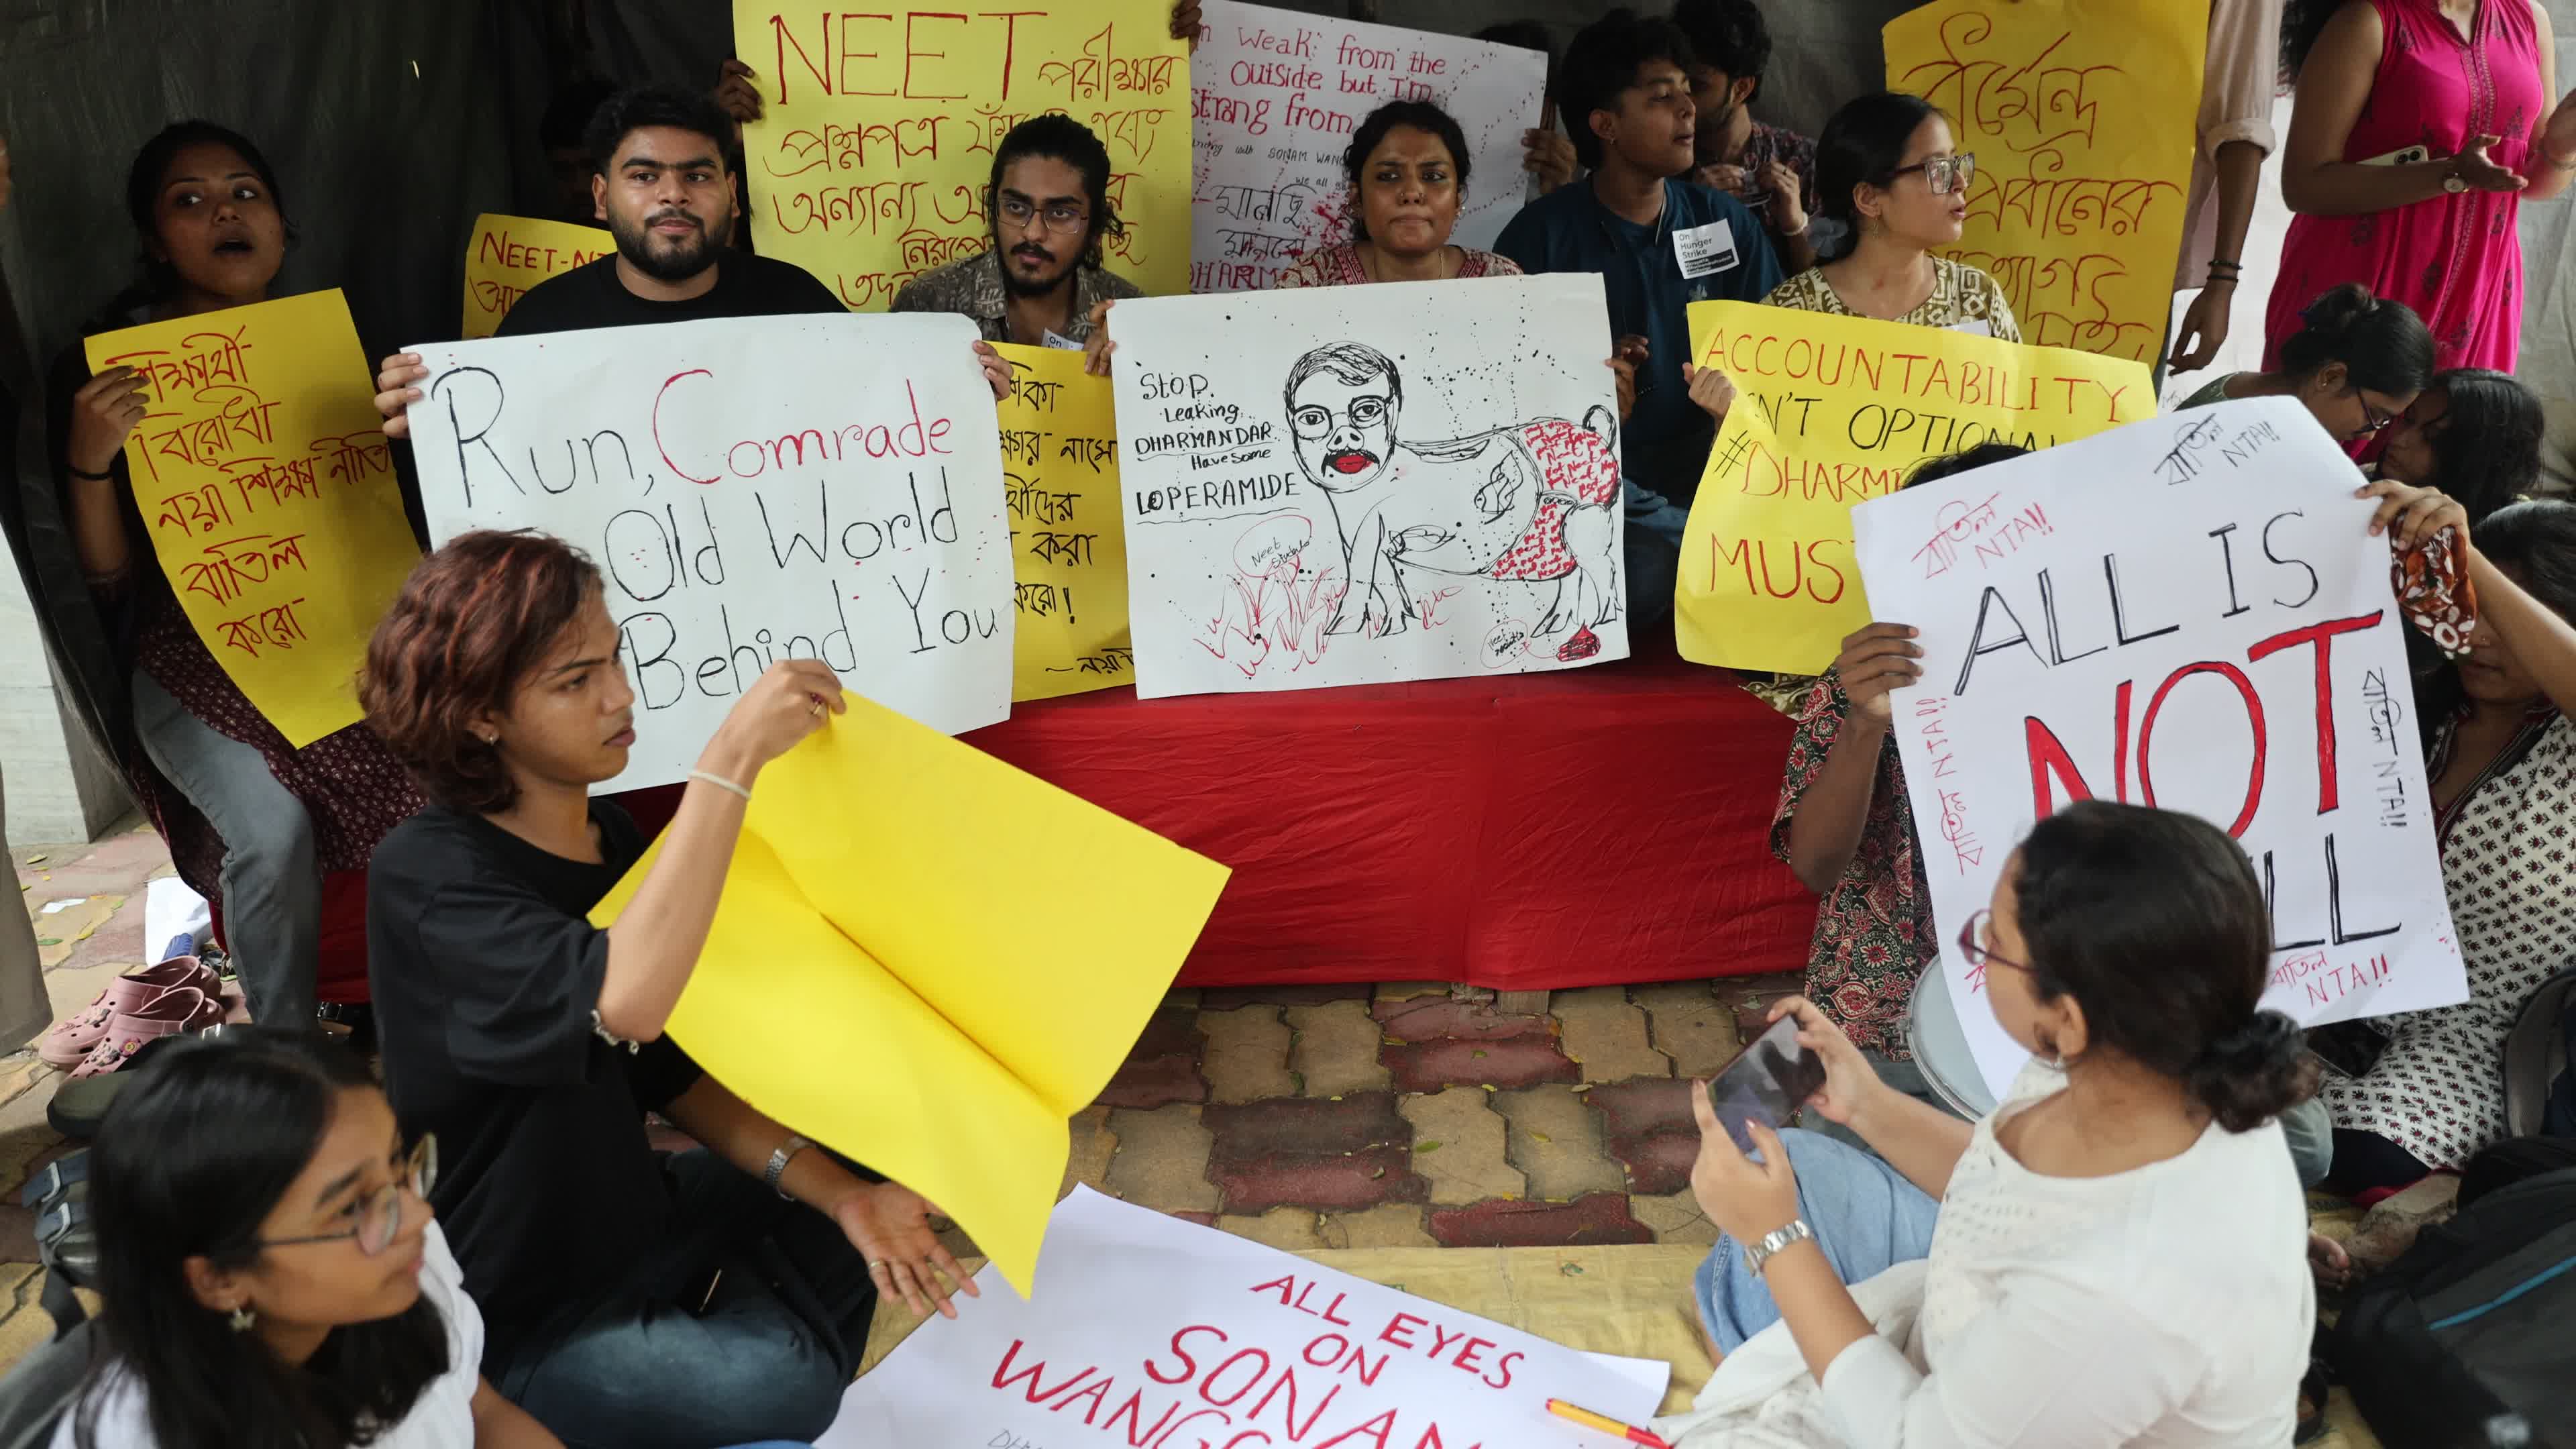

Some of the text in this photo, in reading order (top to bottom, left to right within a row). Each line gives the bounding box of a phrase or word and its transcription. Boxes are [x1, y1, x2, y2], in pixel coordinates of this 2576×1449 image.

[769, 12, 1048, 105] NEET
[1038, 22, 1185, 101] পরীক্ষার
[1336, 34, 1396, 70] from
[1408, 51, 1447, 75] the
[1337, 69, 1378, 94] but
[1284, 92, 1354, 134] from
[763, 115, 949, 176] প্রশ্নপত্র
[1267, 147, 1309, 162] SONAM
[773, 182, 928, 236] অন্যান্য
[1678, 233, 1690, 241] On
[1680, 237, 1713, 250] Hunger
[1681, 248, 1708, 259] Strike
[1049, 336, 1062, 347] On
[1705, 327, 2129, 423] ACCOUNTABILITY
[431, 366, 954, 508] Run, Comrade
[1134, 421, 1272, 455] DHARMANDAR
[1191, 454, 1228, 470] Have
[2220, 421, 2281, 468] NTA!!
[1136, 472, 1301, 516] LOPERAMIDE
[604, 465, 959, 602] Old World
[1974, 502, 2055, 570] NTA!!
[181, 534, 307, 607] বাতিল
[1710, 532, 1857, 605] MUS
[1953, 510, 2320, 697] ALL IS
[619, 568, 999, 711] Behind You
[2024, 609, 2383, 841] NOT
[2305, 952, 2394, 1009] NTA!!
[1249, 1273, 1526, 1391] ALL EYES
[1302, 1332, 1391, 1387] ON
